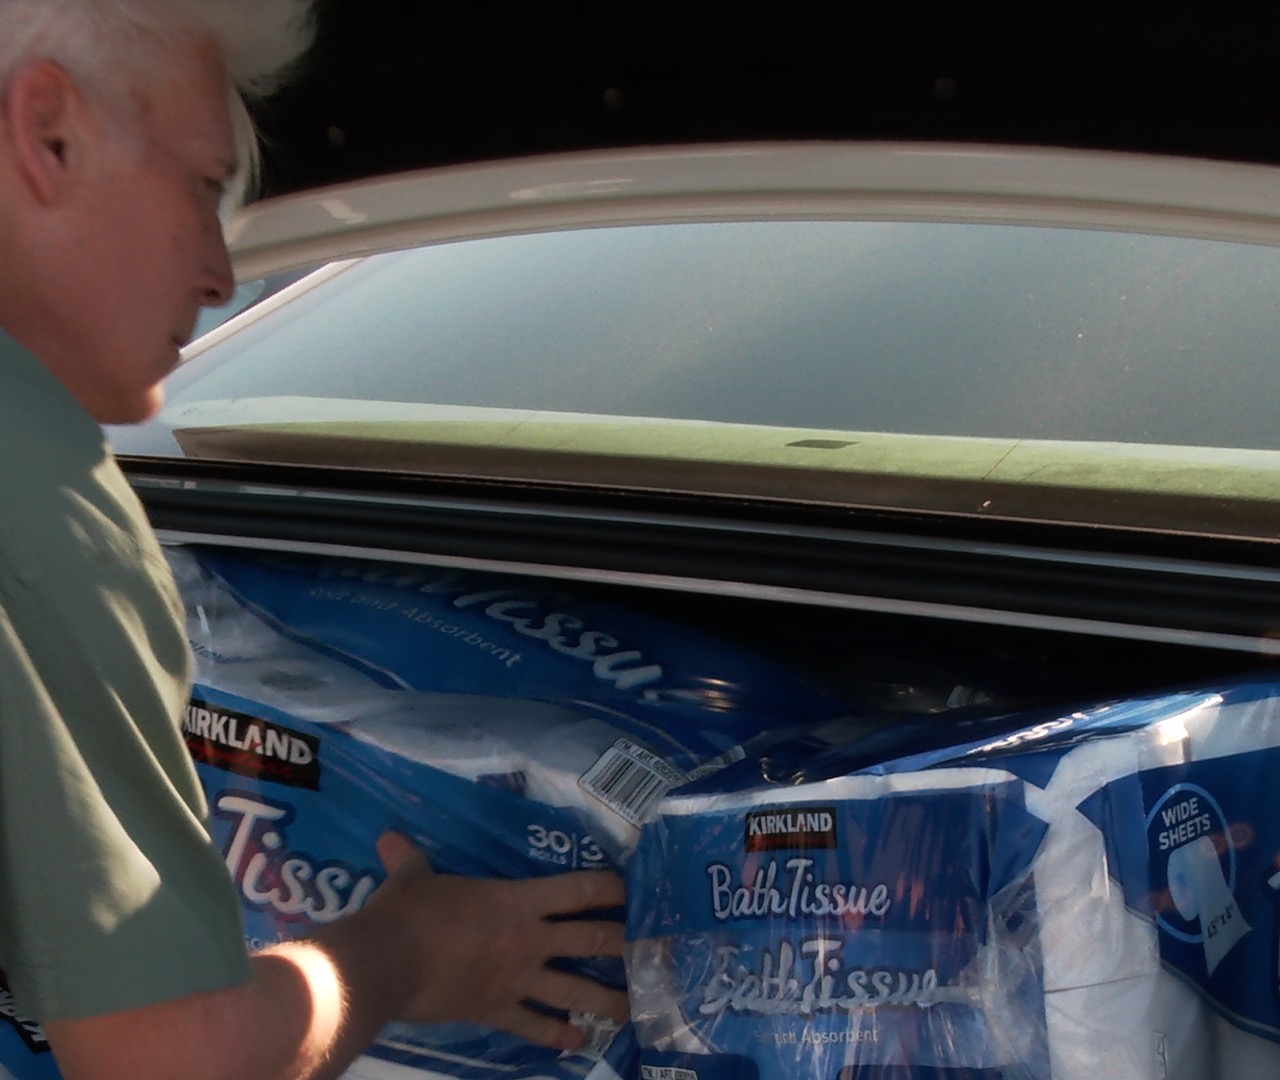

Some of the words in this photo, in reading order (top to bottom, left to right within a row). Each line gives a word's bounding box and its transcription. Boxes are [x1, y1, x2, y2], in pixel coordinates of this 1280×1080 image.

[749, 812, 832, 836] KIRKLAND
[1161, 797, 1199, 828] WIDE
[527, 824, 571, 854] 30
[1158, 813, 1211, 850] SHEETS
[708, 858, 788, 919] Bath
[786, 857, 891, 918] Tissue
